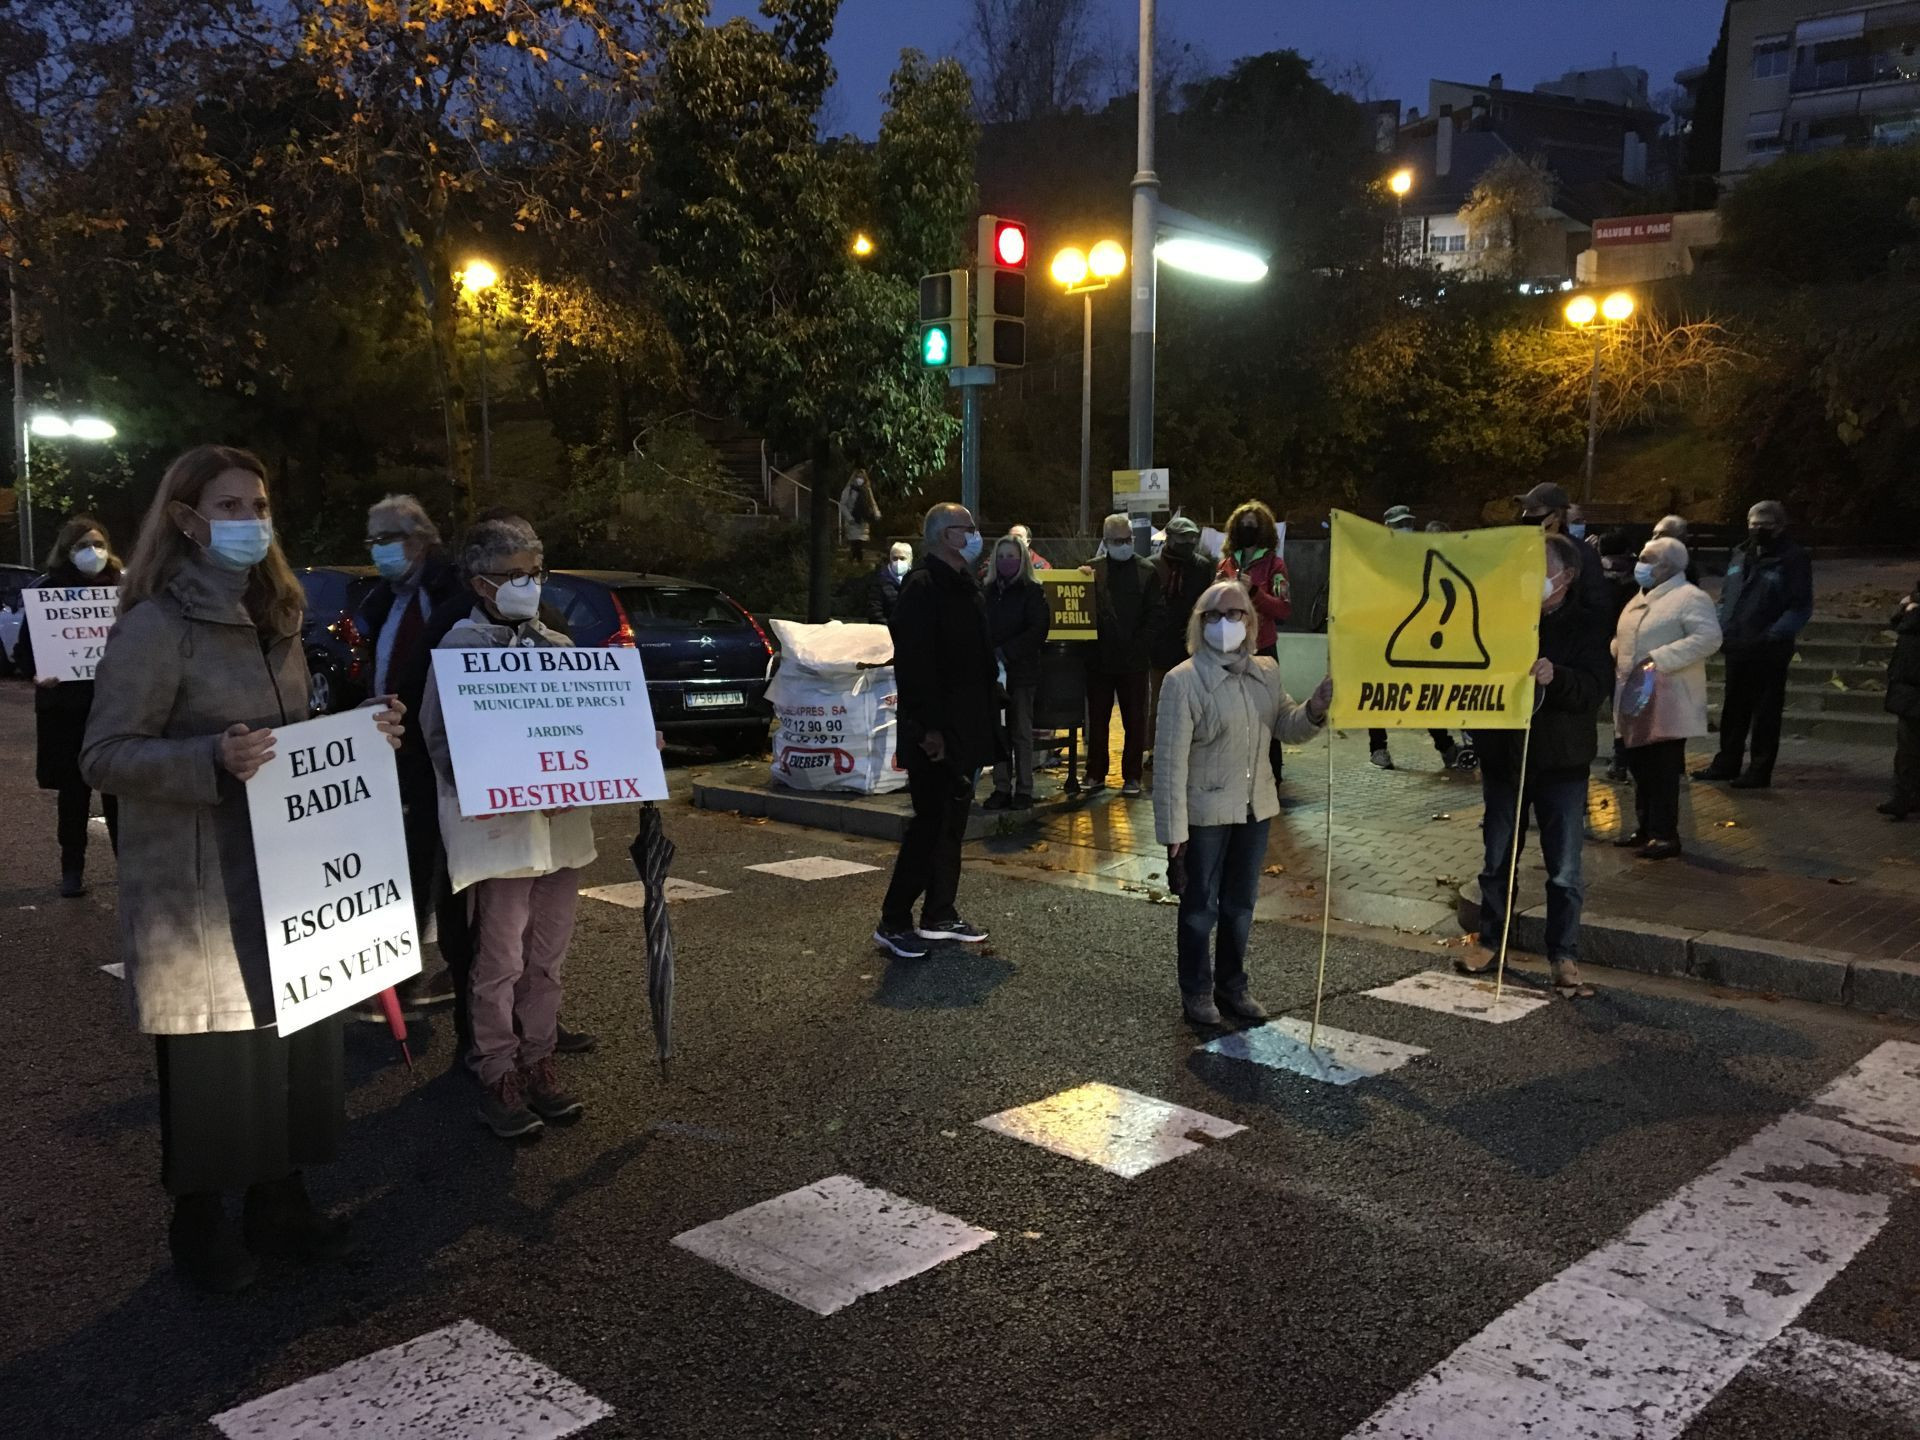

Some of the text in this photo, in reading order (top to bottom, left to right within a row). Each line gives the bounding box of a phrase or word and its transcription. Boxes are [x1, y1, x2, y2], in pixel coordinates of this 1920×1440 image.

[1597, 223, 1671, 239] SALVEM EL PARC
[1057, 585, 1085, 598] PARC
[1065, 599, 1079, 611] EN
[1055, 611, 1091, 624] PERILL
[461, 651, 621, 673] ELOI BADIA
[457, 681, 632, 696] PRESIDENT DE L'INSTITUT
[1357, 683, 1506, 711] PARC EN PERILL
[473, 696, 625, 711] MUNICIPAL DE PARCS I
[526, 725, 584, 738] JARDINS
[794, 720, 805, 733] 12
[808, 720, 822, 733] 90
[826, 720, 842, 732] 90
[288, 737, 356, 778] ELOI
[538, 750, 590, 773] ELS
[789, 755, 831, 769] EVEREST
[284, 775, 371, 822] BADIA
[486, 778, 642, 810] DESTRUEIX
[322, 852, 361, 888] NO
[280, 878, 401, 946] ESCOLTA
[280, 930, 412, 1011] ALS VEÏNS
